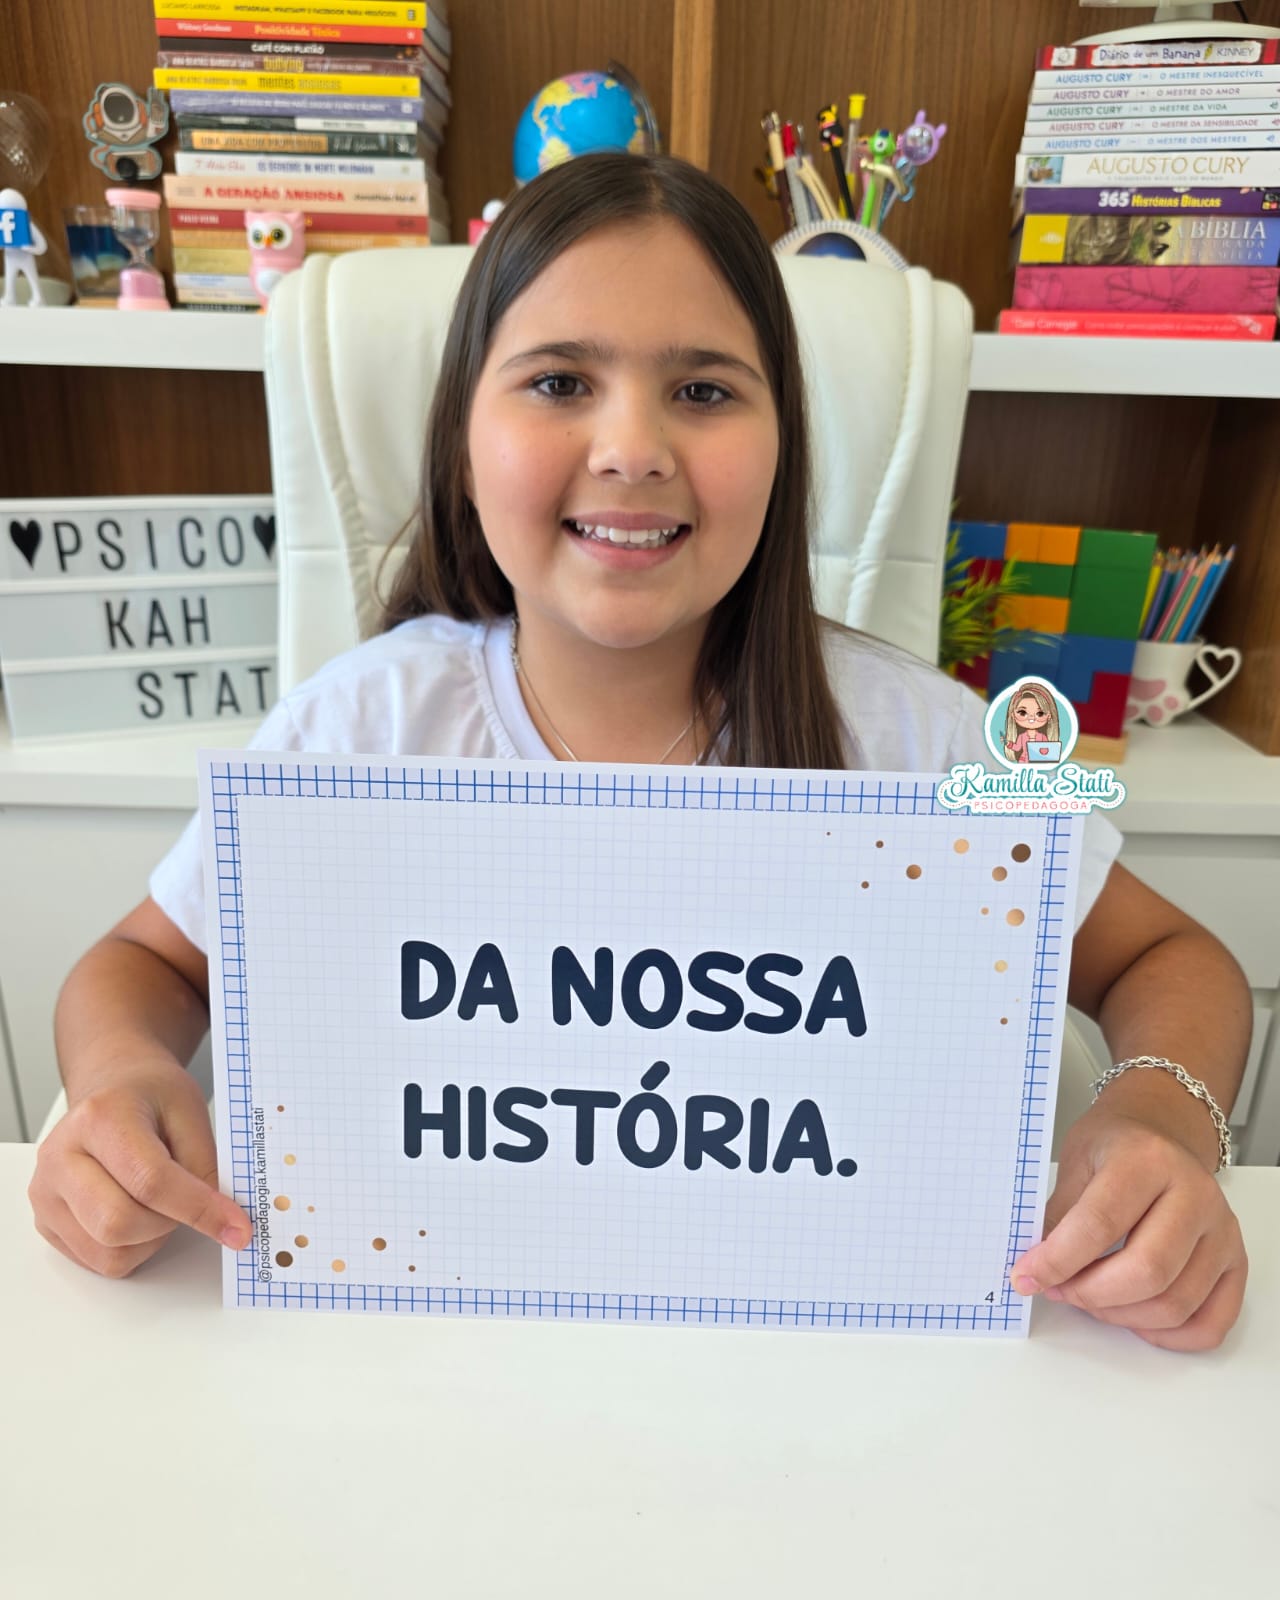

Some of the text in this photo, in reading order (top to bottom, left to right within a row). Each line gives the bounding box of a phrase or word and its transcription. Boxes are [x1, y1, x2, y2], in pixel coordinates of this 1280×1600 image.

[251, 41, 325, 55] CAFÉ COM PLATÃO
[1099, 48, 1129, 61] Diário
[1133, 50, 1144, 59] de
[1162, 47, 1201, 60] Banana
[1216, 47, 1255, 57] KINNEY
[1055, 74, 1103, 84] AUGUSTO
[1105, 73, 1133, 82] CURY
[1169, 71, 1201, 80] MESTRE
[1203, 69, 1264, 79] INESQUECÍVEL
[1053, 87, 1241, 100] AUGUSTO CURY O MESTRE DO AMOR
[1047, 106, 1094, 116] AUGUSTO
[1096, 105, 1123, 115] CURY
[1159, 104, 1191, 112] MESTRE
[1192, 103, 1205, 111] DA
[1207, 103, 1227, 111] VIDA
[1049, 122, 1096, 132] AUGUSTO
[1098, 121, 1125, 131] CURY
[1160, 120, 1190, 128] MESTRE
[1190, 119, 1202, 127] DA
[1203, 118, 1260, 127] SENSIBILIDADE
[1045, 135, 1248, 149] AUGUSTO CURY O MESTRE DOS MESTRES
[1086, 156, 1251, 175] AUGUSTO CURY
[204, 186, 213, 197] A
[217, 186, 280, 201] GERAÇÃO
[285, 189, 346, 202] ANSIOSA
[1098, 191, 1130, 208] 365
[1190, 219, 1268, 240] BÍBLIA
[53, 516, 246, 572] PSICO
[104, 595, 210, 649] KAH
[401, 940, 867, 1037] DA NOSSA
[403, 1060, 858, 1177] HISTÓRIA.
[253, 1107, 273, 1283] @psicopedagogia.kamillastati
[984, 1291, 995, 1303] 4
